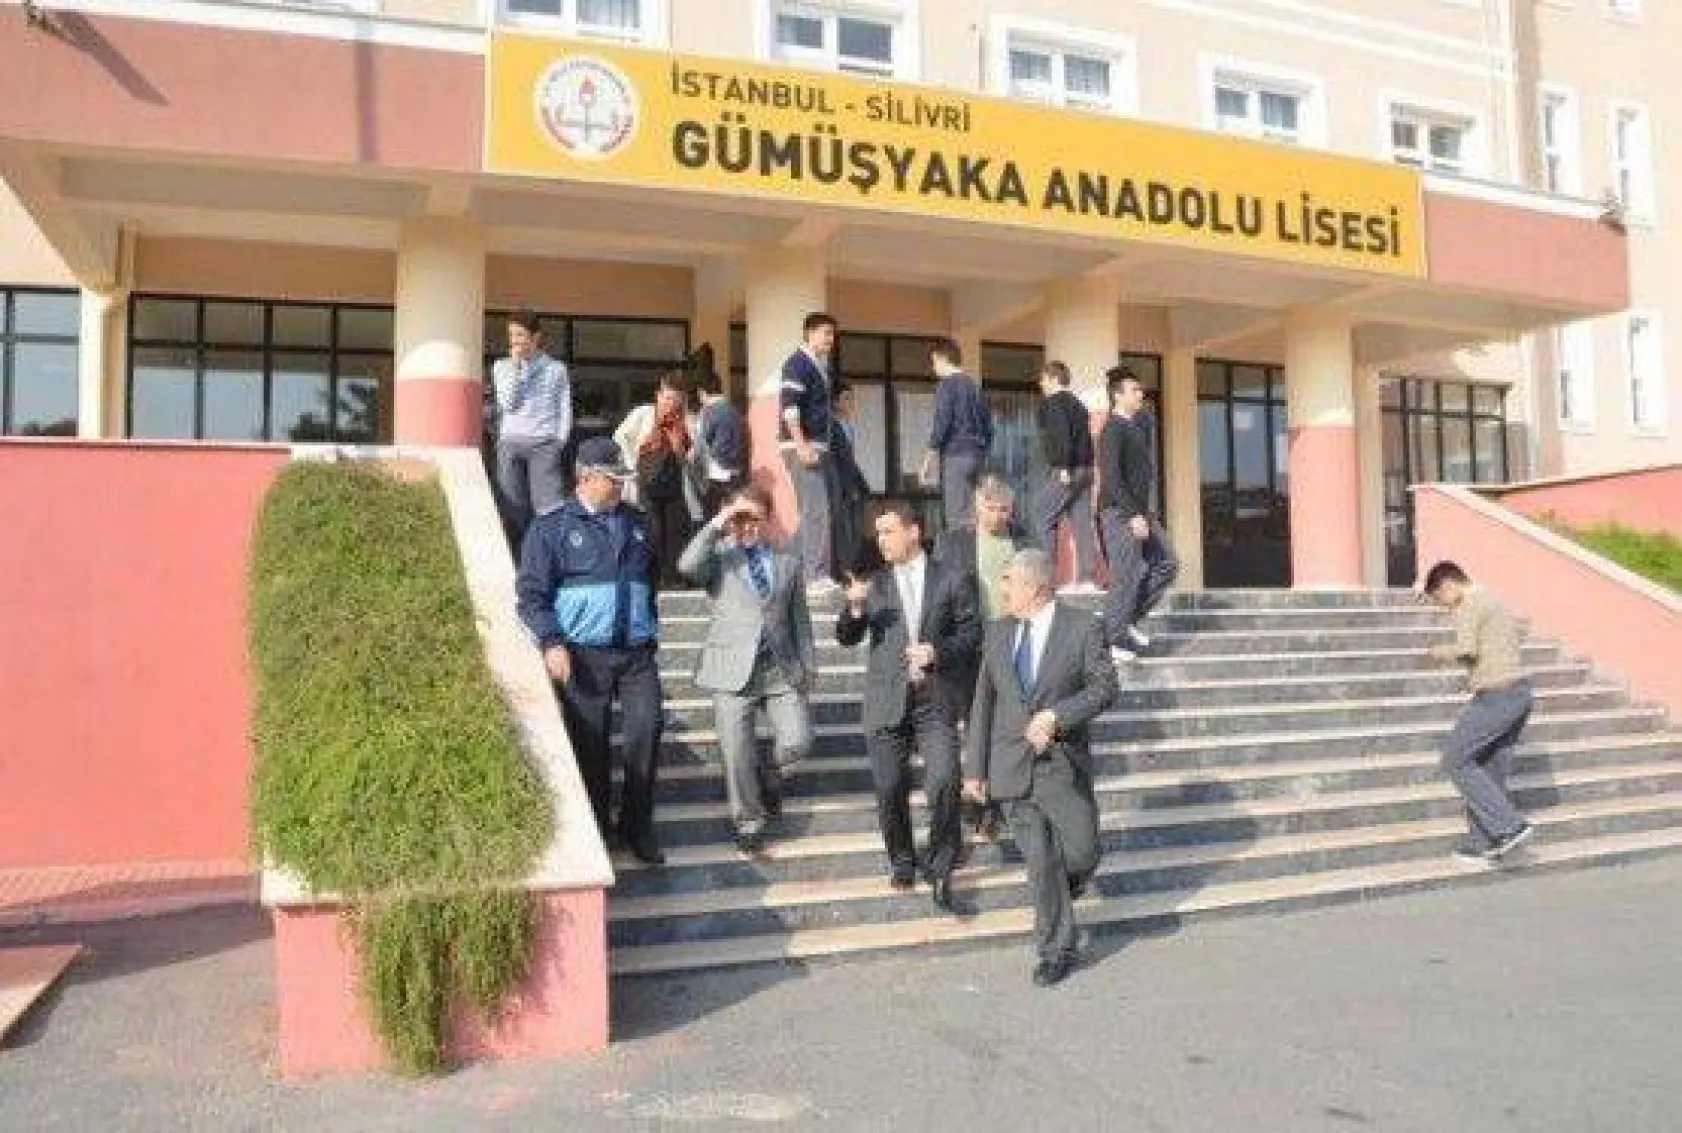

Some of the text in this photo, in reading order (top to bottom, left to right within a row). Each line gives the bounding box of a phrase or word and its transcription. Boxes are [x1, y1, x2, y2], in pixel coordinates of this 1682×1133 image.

[671, 60, 834, 115] İSTANBUL
[866, 96, 971, 132] SİLİVRİ
[673, 112, 1401, 257] GÜMÜŞYAKA ANADOLU LİSESİ
